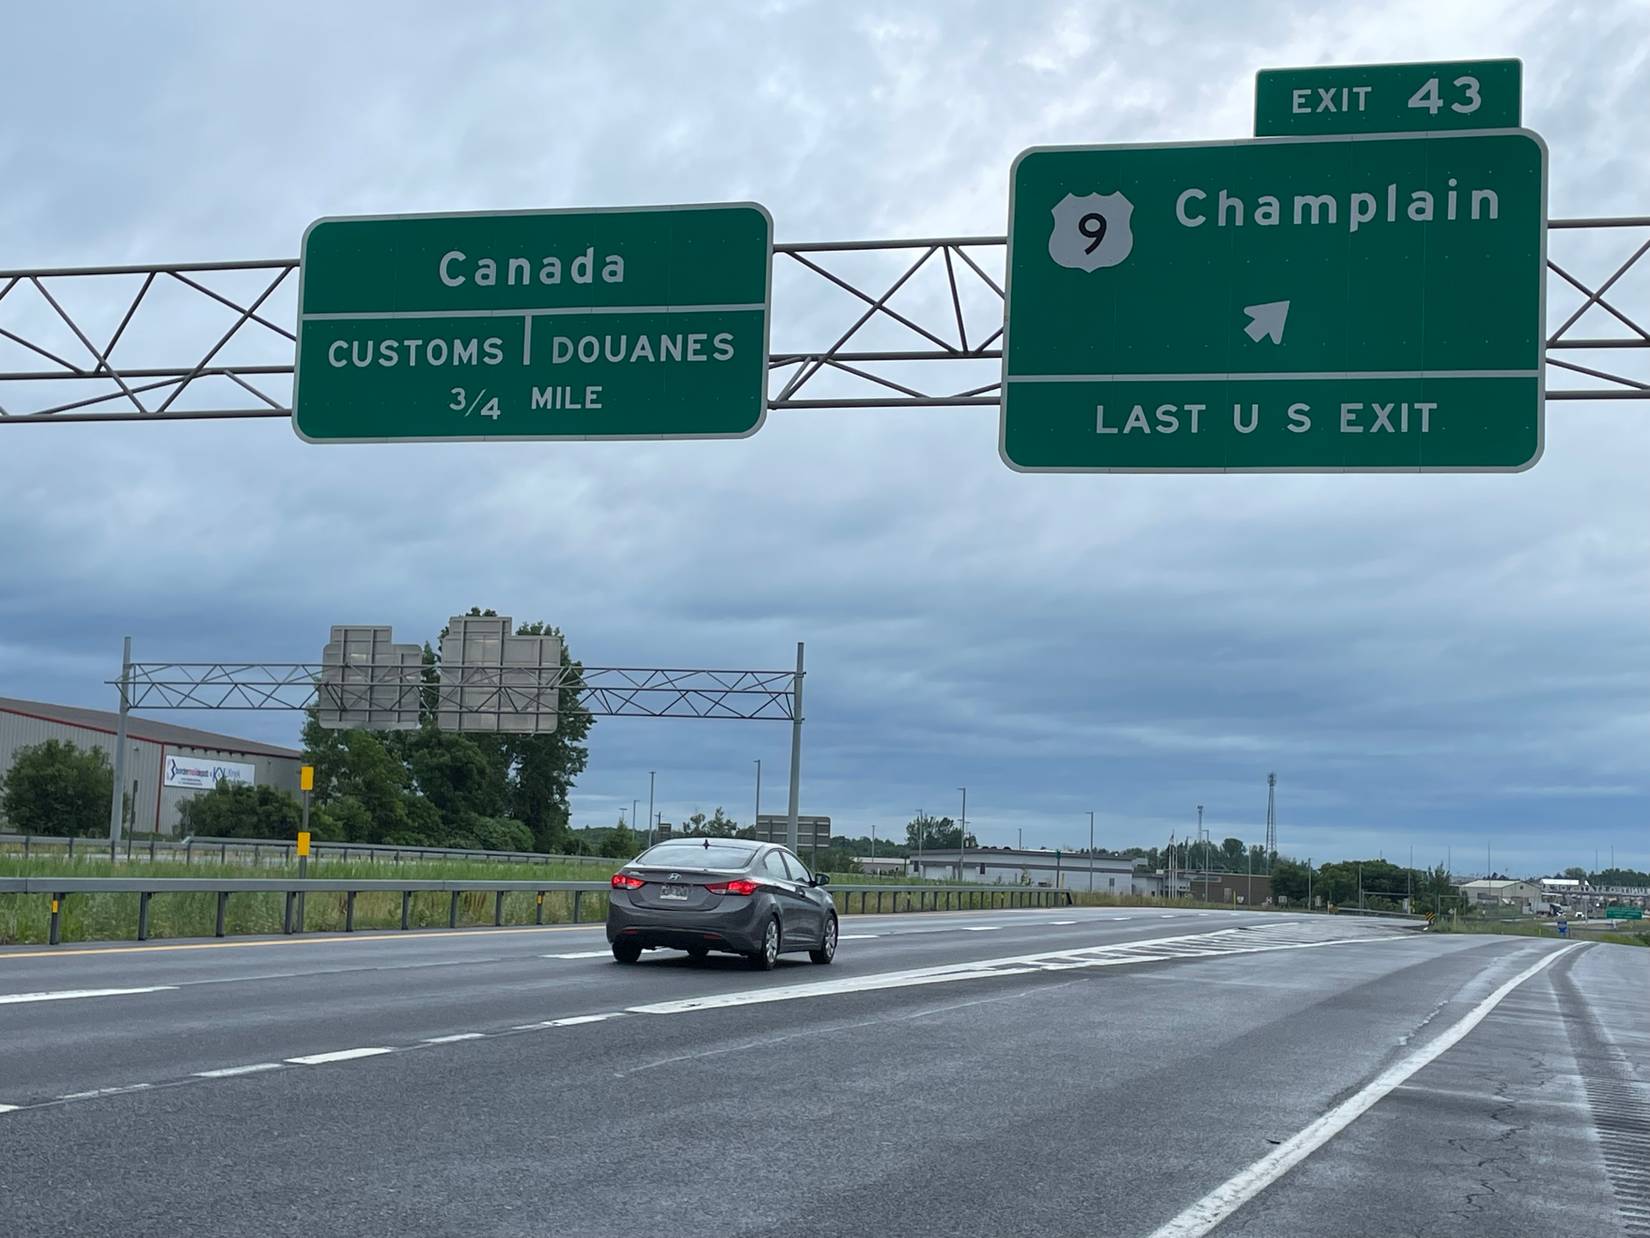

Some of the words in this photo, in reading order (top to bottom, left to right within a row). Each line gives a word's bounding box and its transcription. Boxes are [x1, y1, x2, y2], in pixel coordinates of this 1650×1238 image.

[1292, 86, 1372, 114] EXIT
[1407, 76, 1482, 114] 43
[1175, 178, 1499, 233] Champlain
[1078, 212, 1108, 256] 9
[439, 246, 625, 287] Canada
[328, 337, 504, 368] CUSTOMS
[552, 332, 735, 364] DOUANES
[449, 387, 501, 420] 3/4
[531, 386, 603, 410] MILE
[1096, 404, 1207, 434] LAST
[1233, 404, 1260, 434] U
[1287, 403, 1312, 433] S
[1340, 403, 1438, 433] EXIT
